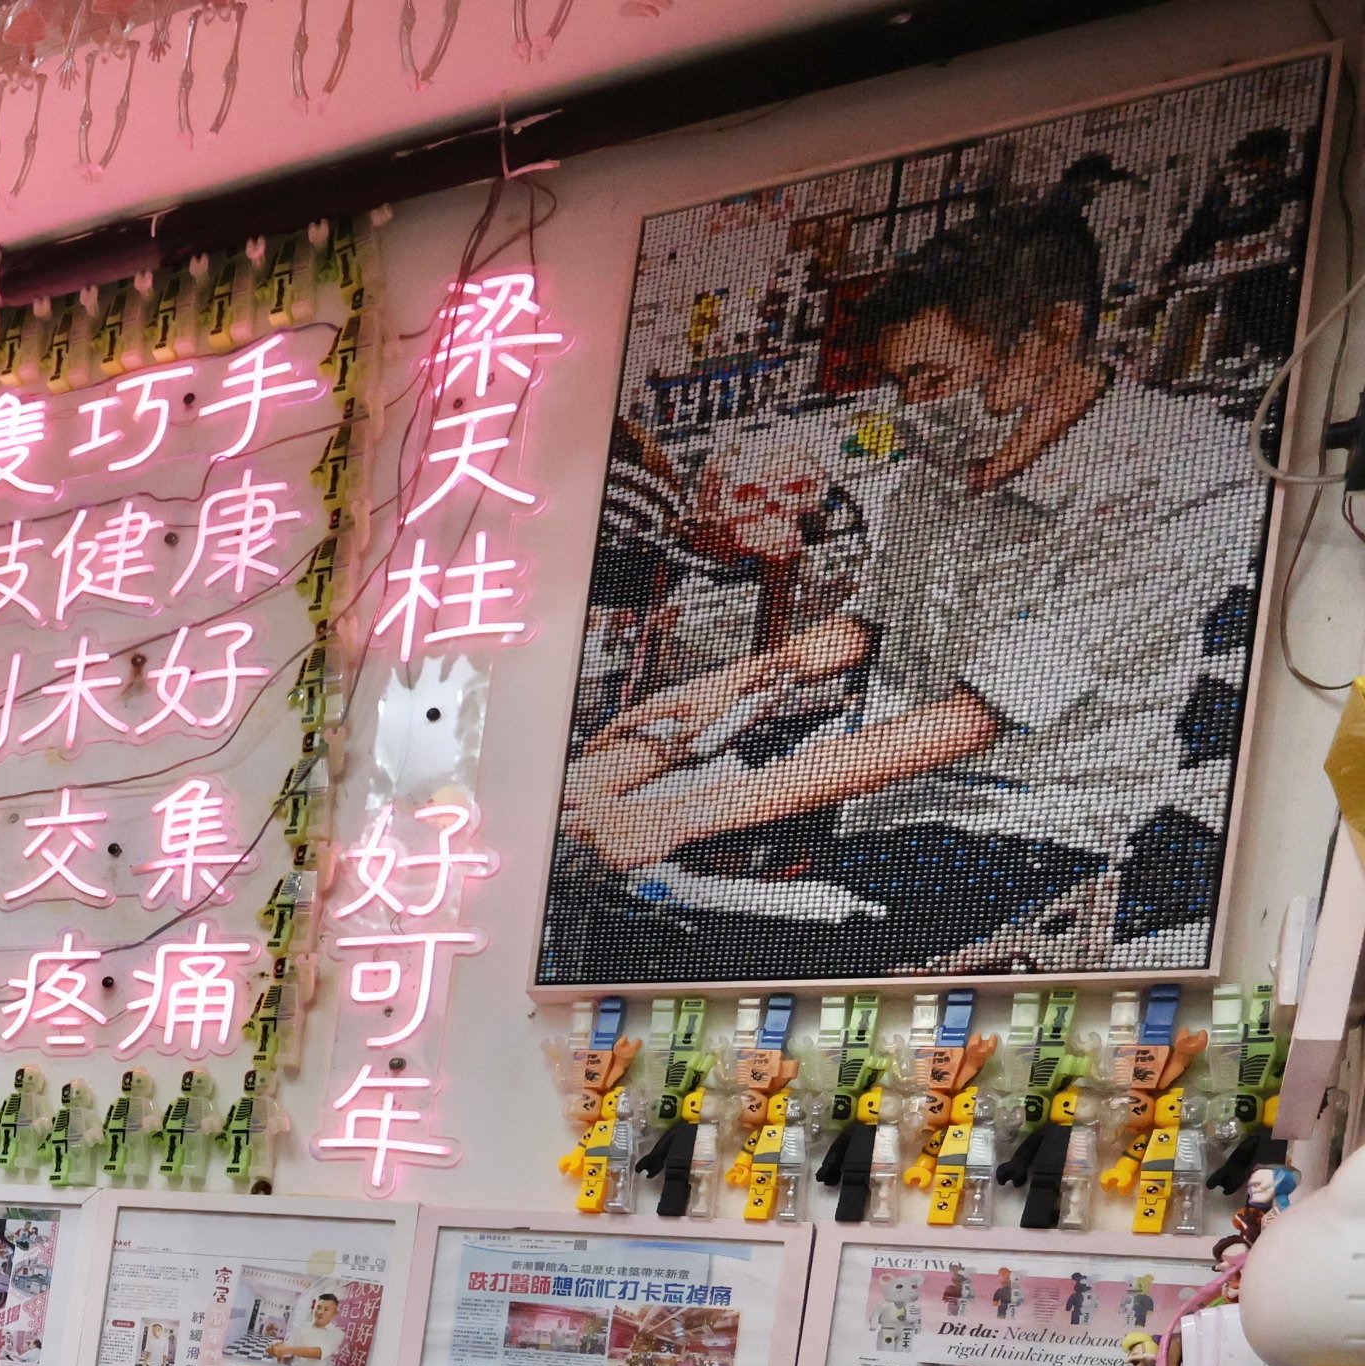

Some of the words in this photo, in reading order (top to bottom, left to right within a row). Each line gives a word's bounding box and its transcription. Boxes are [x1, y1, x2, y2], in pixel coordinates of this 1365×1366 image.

[374, 270, 567, 663] 梁天柱
[314, 801, 490, 1190] 好可年
[873, 1255, 920, 1269] PAGE
[468, 1271, 733, 1307] 跌打醫師想你忙打卡忘掉痛
[938, 1321, 968, 1337] Dit
[971, 1325, 1000, 1340] da:
[1003, 1326, 1046, 1343] Need
[1050, 1330, 1066, 1344] to
[946, 1341, 987, 1358] rigid
